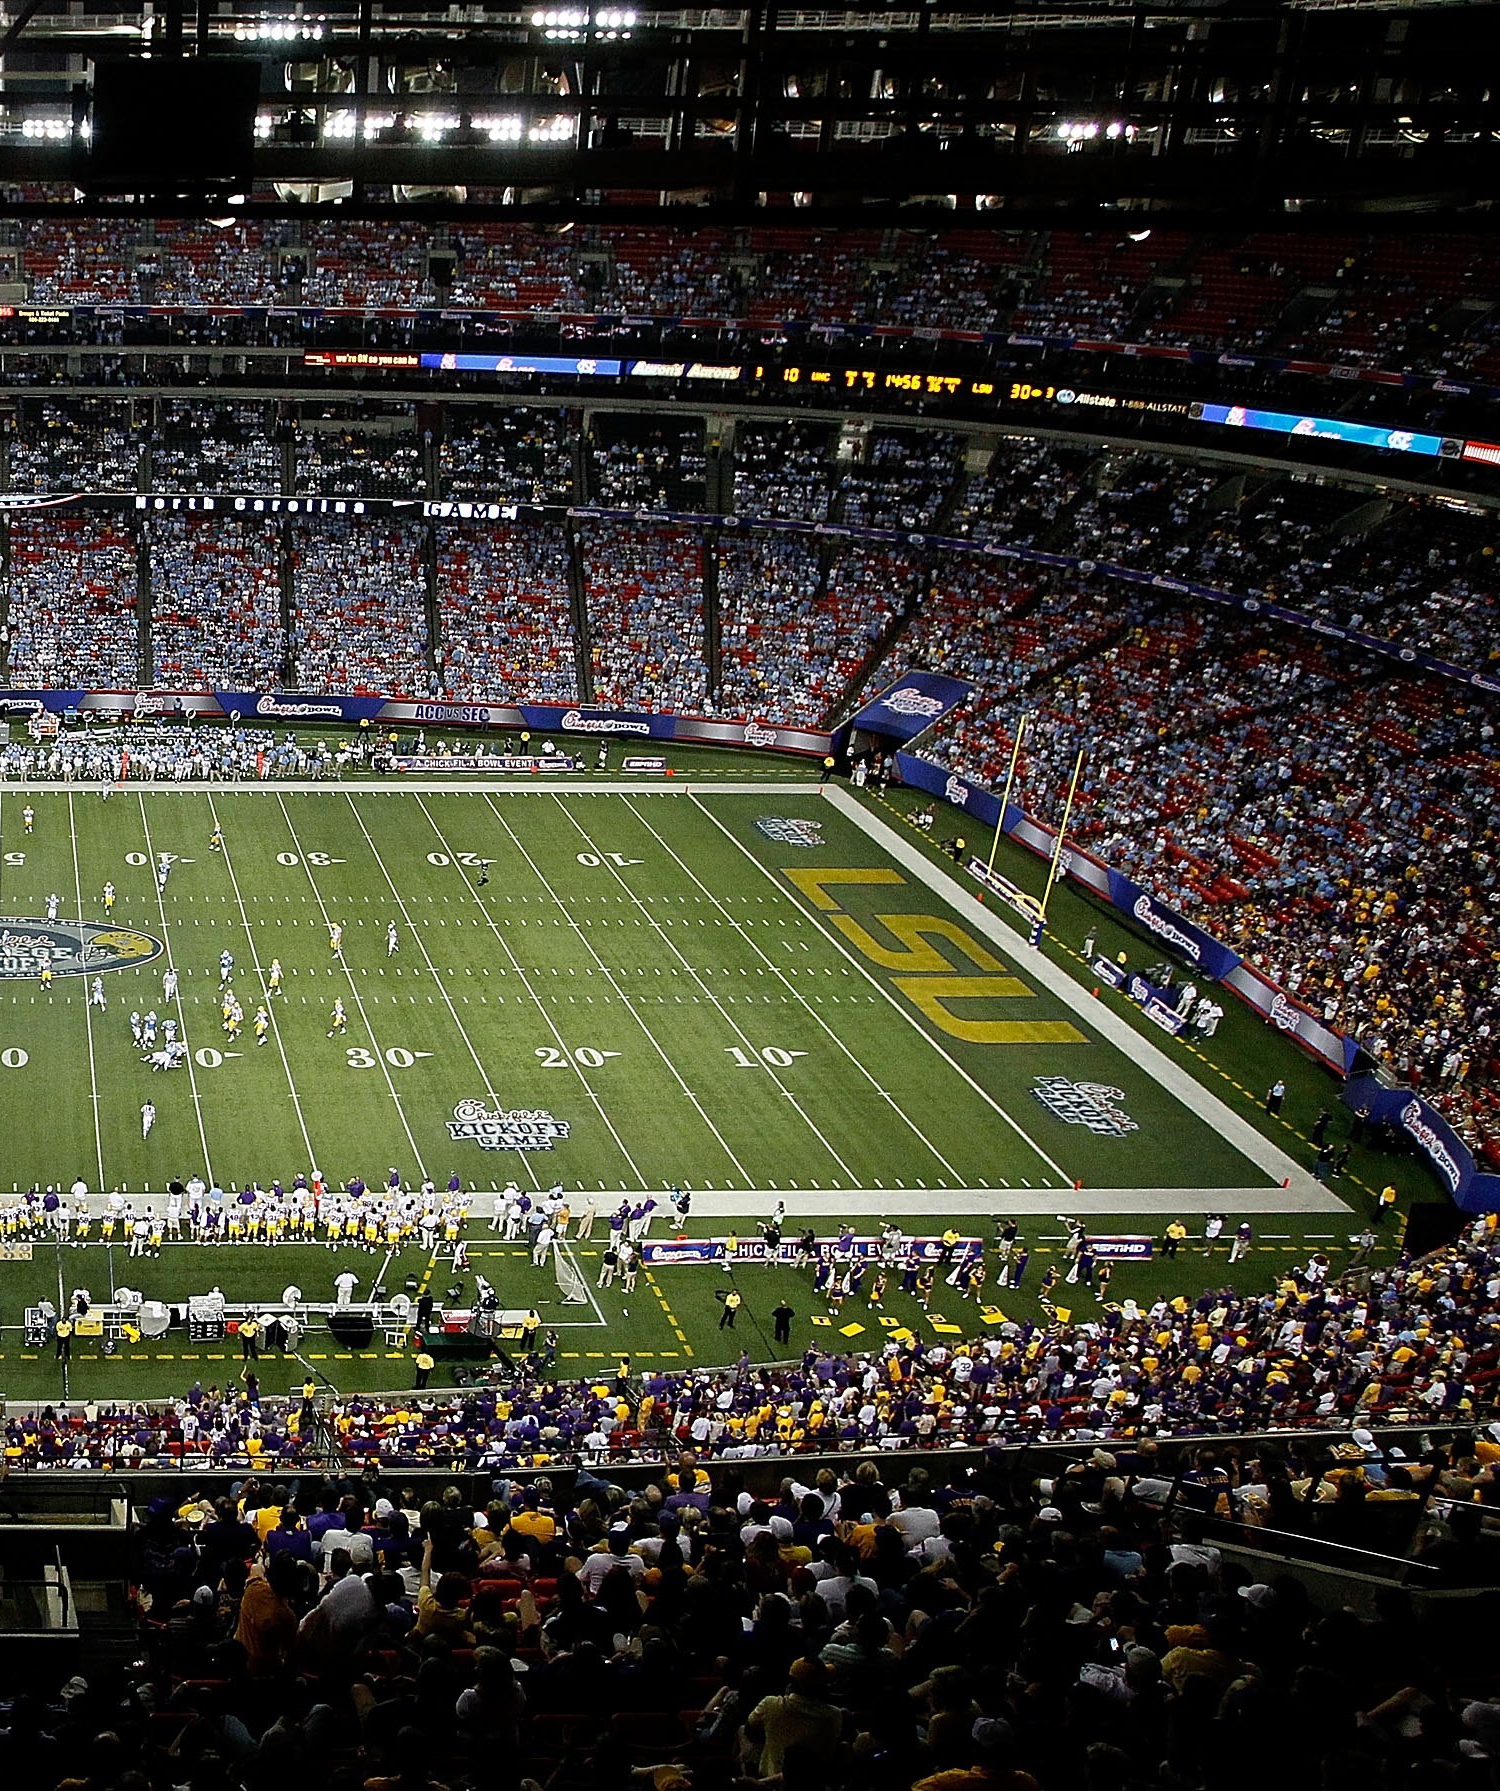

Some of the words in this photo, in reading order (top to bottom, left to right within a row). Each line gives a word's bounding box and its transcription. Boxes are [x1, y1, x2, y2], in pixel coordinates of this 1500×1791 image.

[335, 355, 357, 365] we're
[369, 357, 377, 365] so
[378, 357, 392, 367] you
[393, 357, 407, 365] can
[408, 356, 418, 365] be
[631, 361, 684, 377] Aaron's
[687, 363, 741, 379] Aaron's
[784, 368, 799, 383] 10
[972, 382, 993, 395] LSU
[1011, 384, 1031, 400] 30
[1074, 393, 1116, 408] Allstate
[306, 705, 342, 715] BOWL
[415, 705, 445, 720] ACC
[612, 721, 650, 735] BOWL
[424, 760, 475, 768] CHICK-FIL-A
[477, 760, 503, 768] BOWL
[505, 760, 533, 768] EVENT
[124, 852, 180, 869] 40
[276, 852, 332, 869] 30
[426, 852, 482, 869] 20
[576, 852, 630, 869] 10
[1171, 930, 1200, 959] BOWL
[780, 867, 1092, 1044] LSU
[346, 1047, 416, 1069] 30
[535, 1046, 604, 1069] 20
[725, 1046, 795, 1068] 10
[1036, 1076, 1124, 1137] KICKOFF
[449, 1120, 570, 1139] KICKOFF
[480, 1135, 549, 1148] GAME
[960, 1363, 972, 1372] 32
